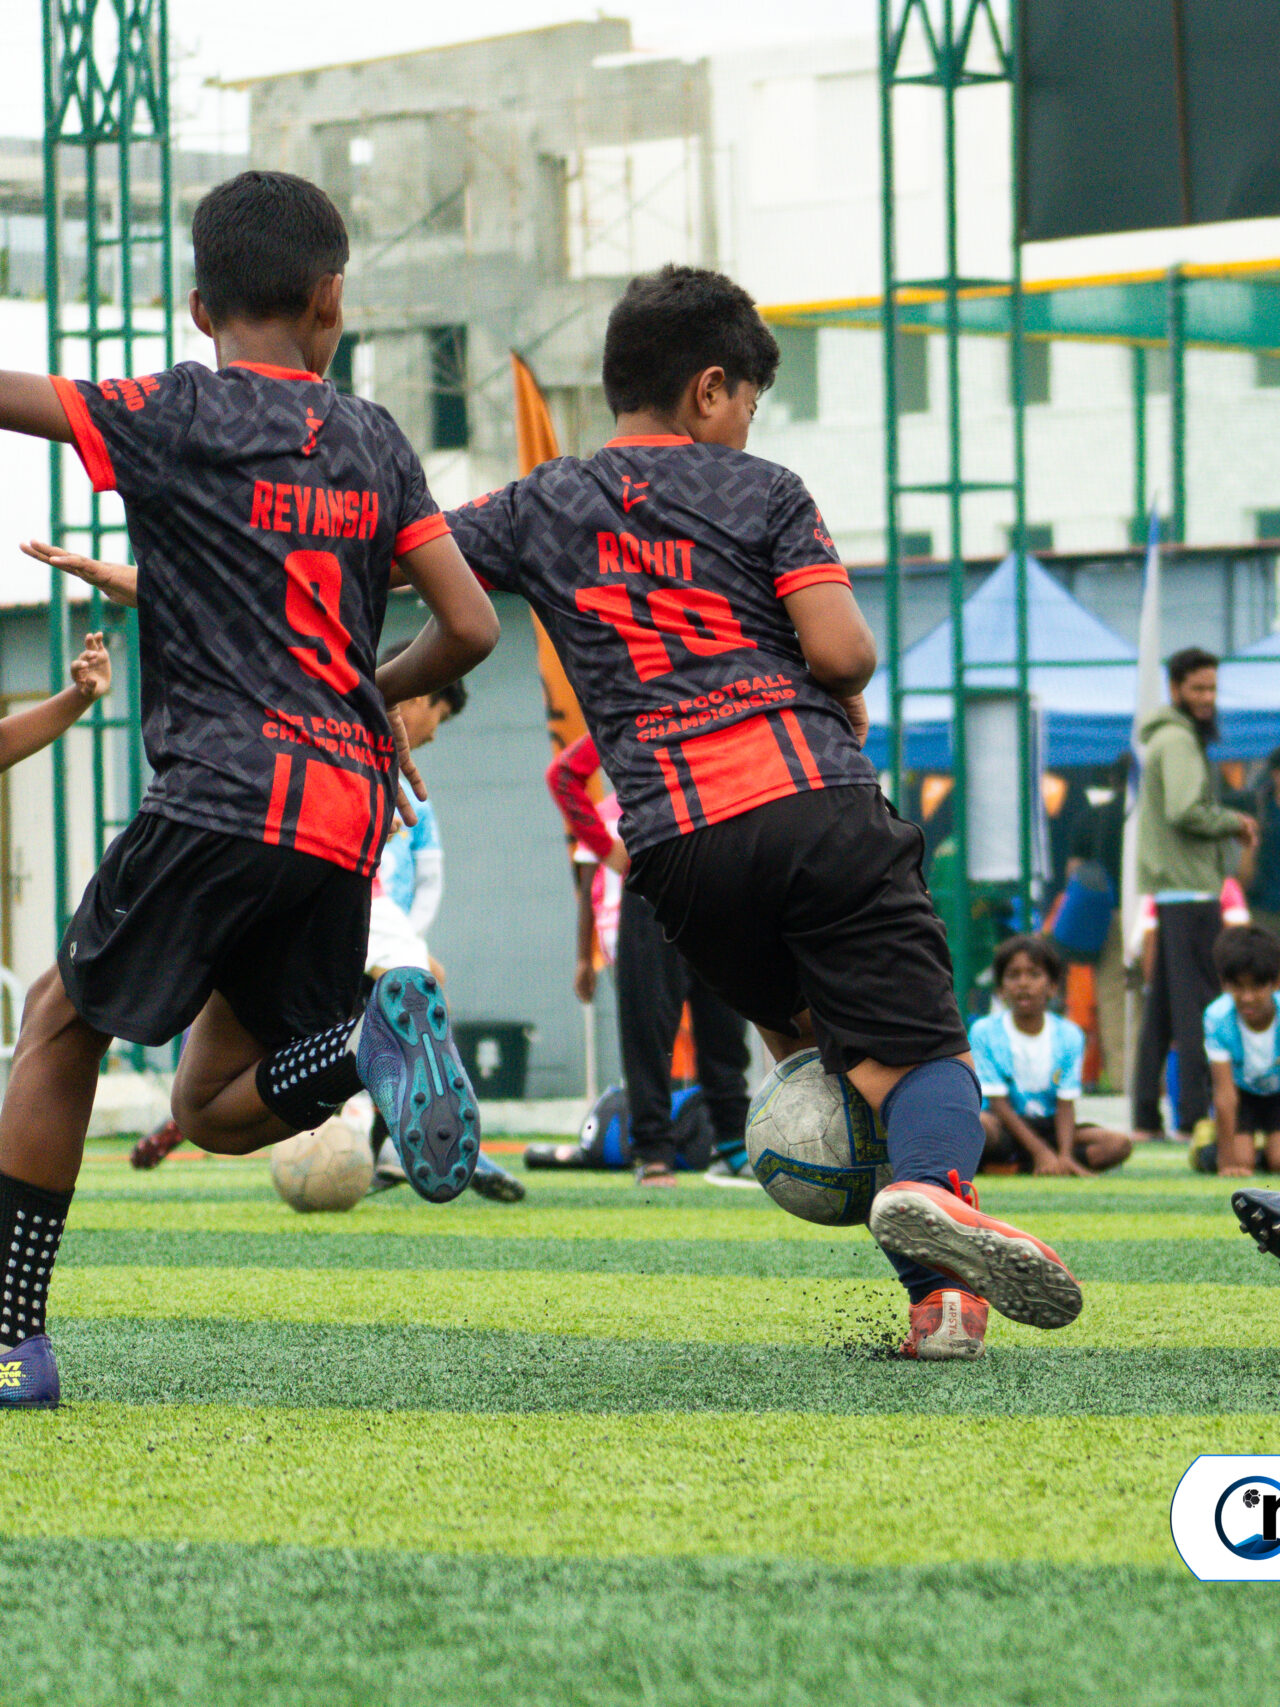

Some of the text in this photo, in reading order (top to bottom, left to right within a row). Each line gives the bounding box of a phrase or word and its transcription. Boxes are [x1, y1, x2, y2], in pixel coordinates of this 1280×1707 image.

[250, 480, 379, 540] REYANSH
[597, 532, 697, 581] ROHIT
[284, 550, 361, 696] 9
[575, 583, 759, 683] 10
[635, 673, 793, 728] ONE FOOTBALL
[636, 688, 797, 743] CHAMPIONSHIP
[310, 716, 394, 753] FOOTLL
